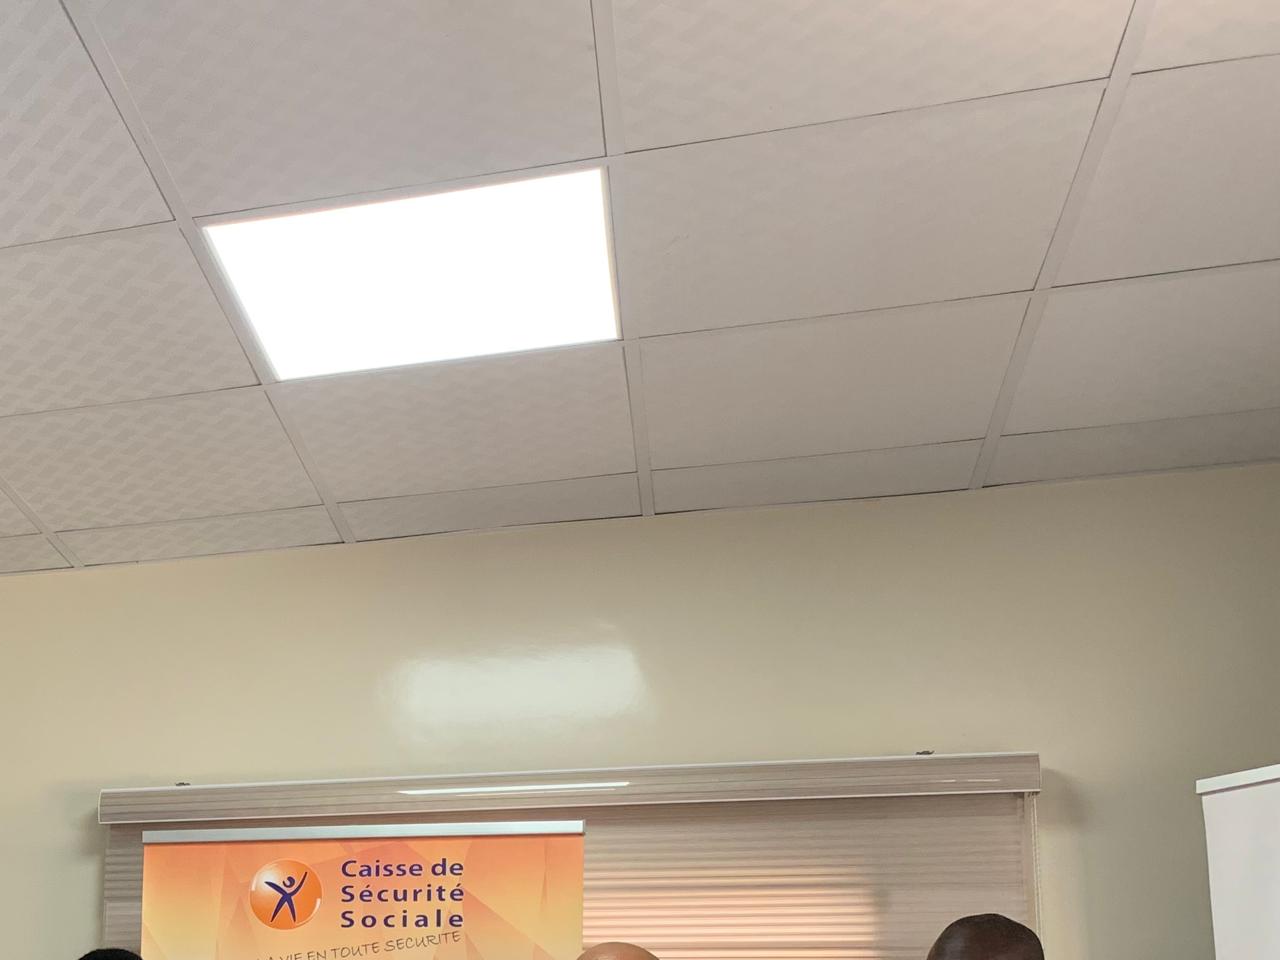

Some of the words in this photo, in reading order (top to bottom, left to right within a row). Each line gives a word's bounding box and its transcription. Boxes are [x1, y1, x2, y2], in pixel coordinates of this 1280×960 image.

[341, 859, 423, 878] Caisse
[431, 857, 464, 877] de
[340, 882, 464, 903] Sécurité
[340, 908, 464, 928] Sociale
[330, 941, 380, 960] TOUTE
[383, 930, 462, 952] SECURITE
